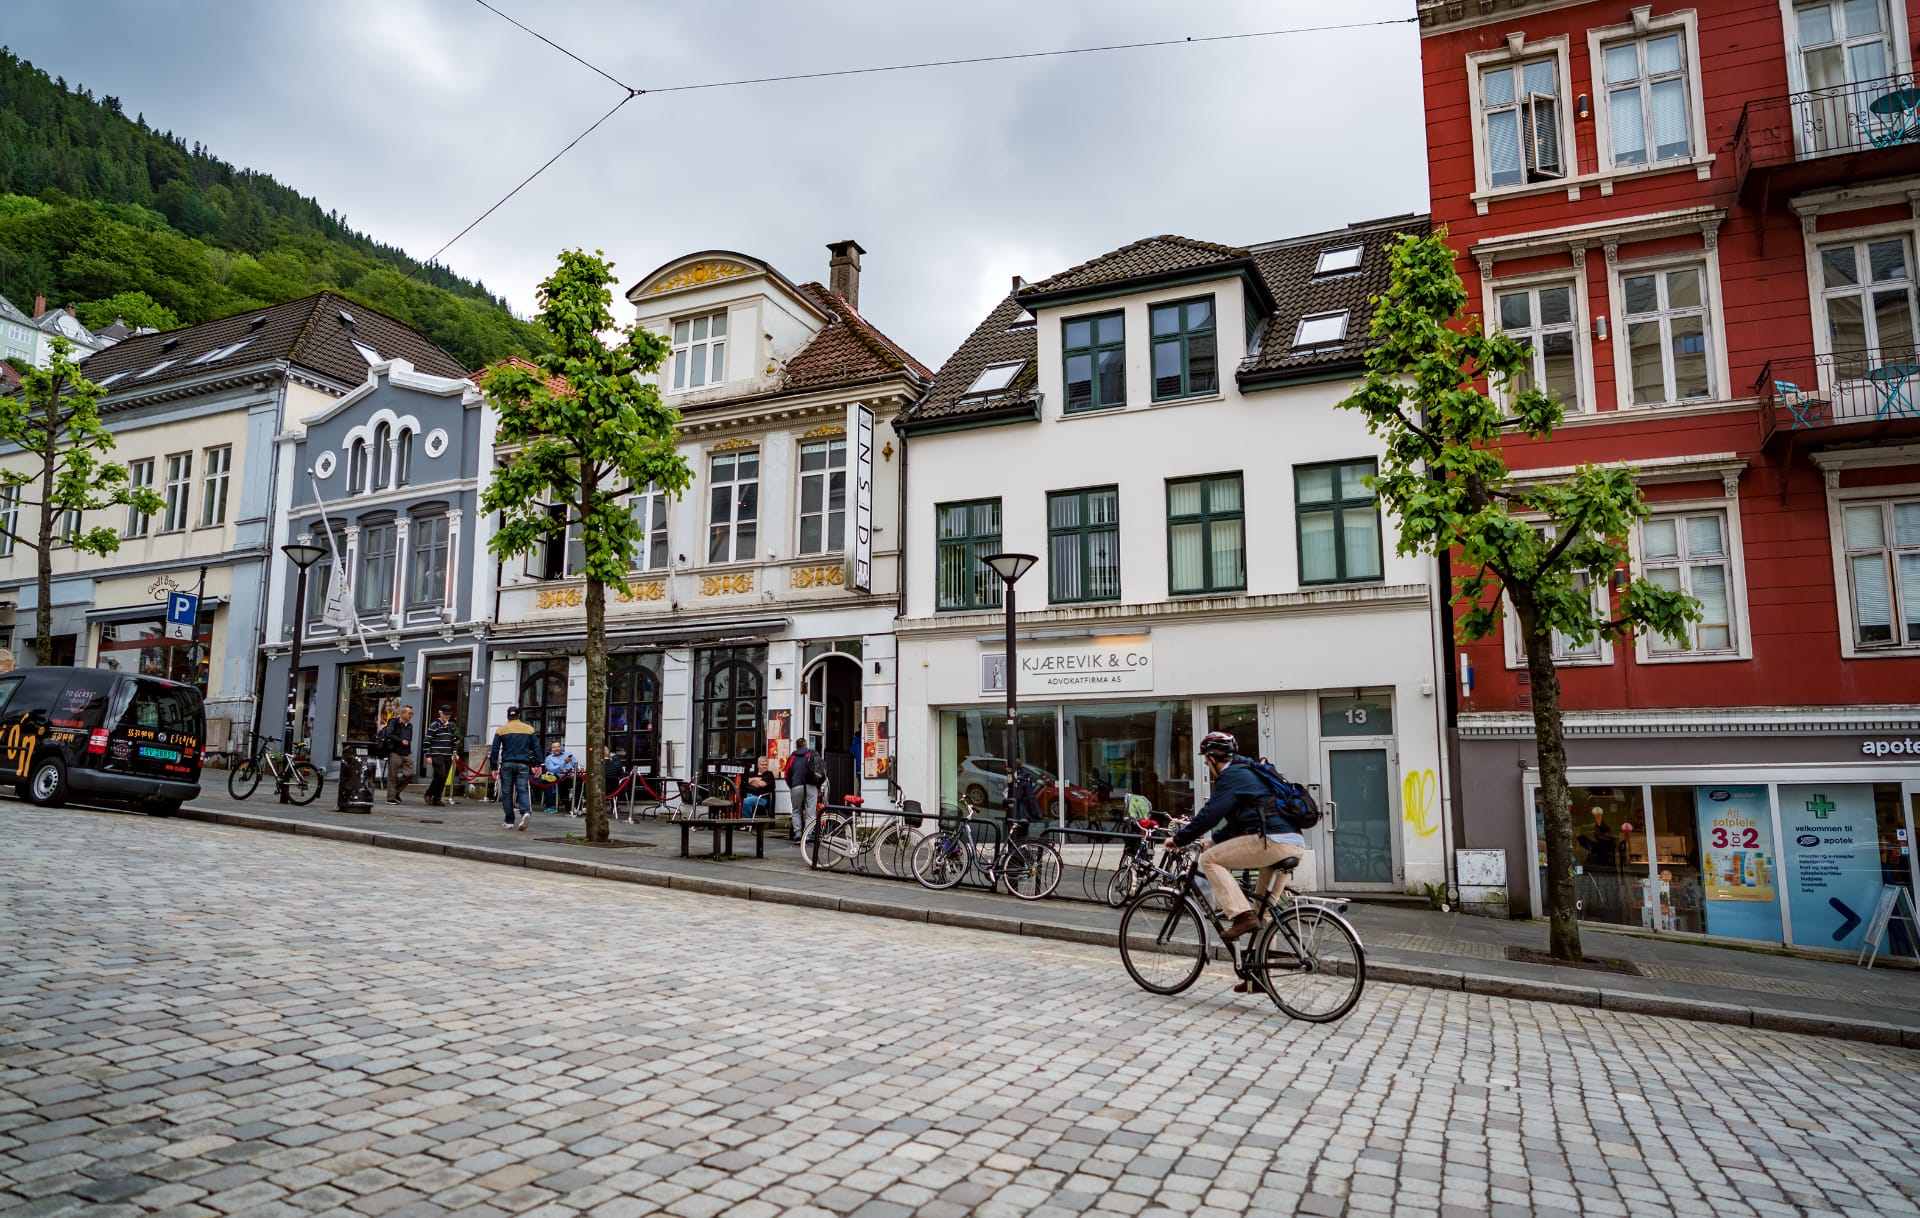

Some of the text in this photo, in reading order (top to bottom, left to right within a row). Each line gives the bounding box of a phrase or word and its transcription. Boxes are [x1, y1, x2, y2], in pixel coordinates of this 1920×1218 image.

[858, 423, 871, 577] INSIDE
[174, 597, 190, 620] P
[1022, 652, 1148, 671] KJÆREVIK & Co
[1047, 675, 1122, 685] ADVOKATFIRMA AS
[1344, 708, 1368, 724] 13
[1712, 818, 1756, 828] solpleie
[1711, 827, 1760, 849] 3 for 2
[1823, 836, 1853, 845] apotek
